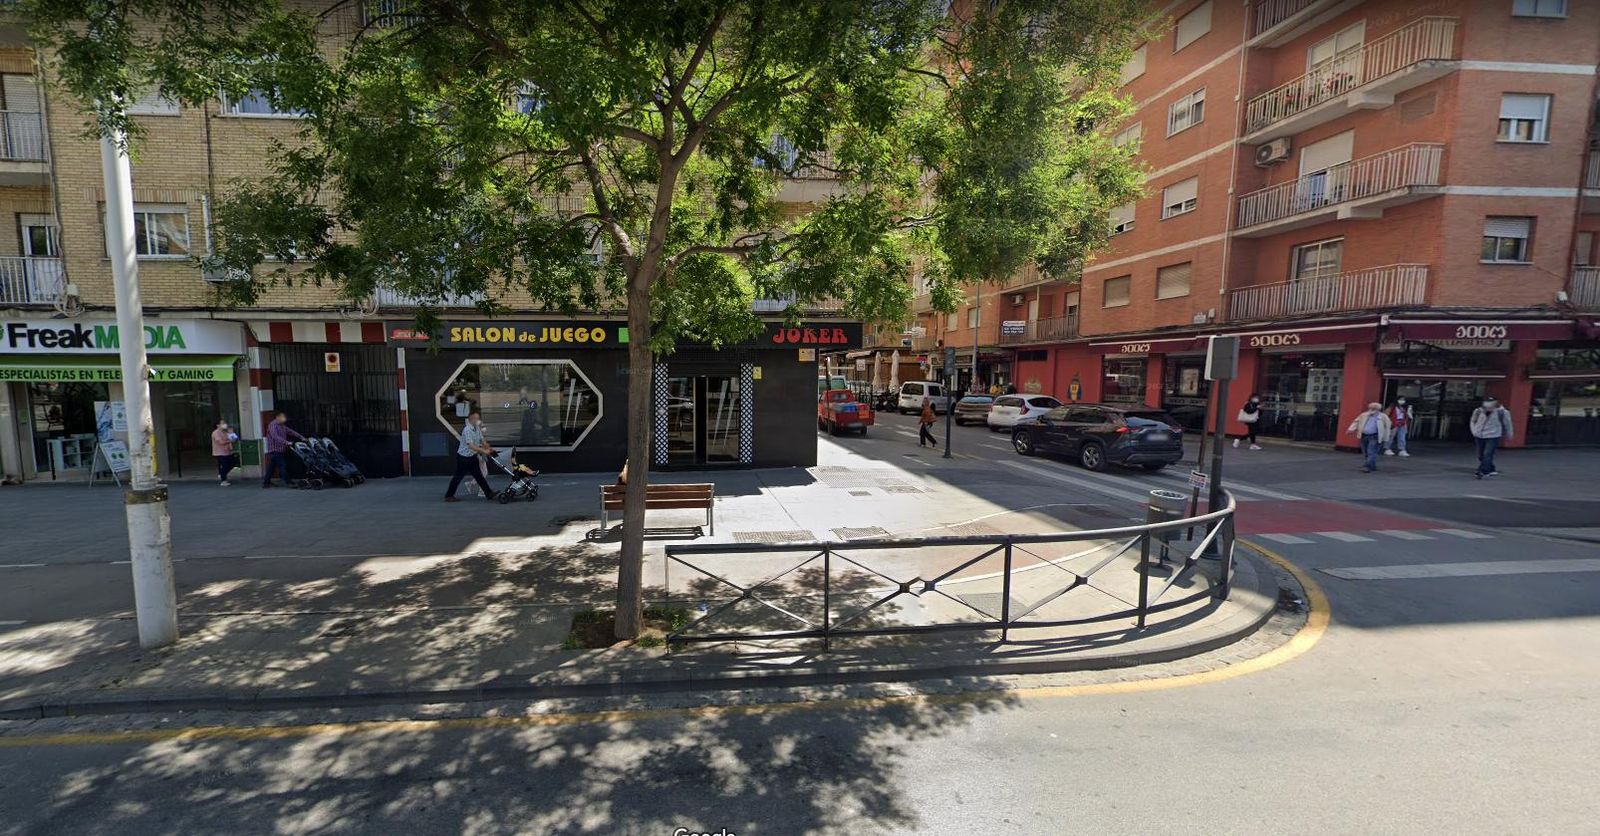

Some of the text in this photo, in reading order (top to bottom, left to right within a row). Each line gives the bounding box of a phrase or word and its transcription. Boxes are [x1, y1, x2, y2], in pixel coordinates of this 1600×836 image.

[7, 323, 186, 348] FreakMDIA
[451, 327, 606, 343] SALON de JUEGO
[772, 328, 848, 344] JOKER
[0, 369, 76, 380] ESPECIALISTAS
[80, 369, 94, 380] EN
[159, 369, 166, 380] Y
[168, 369, 214, 380] GAMING
